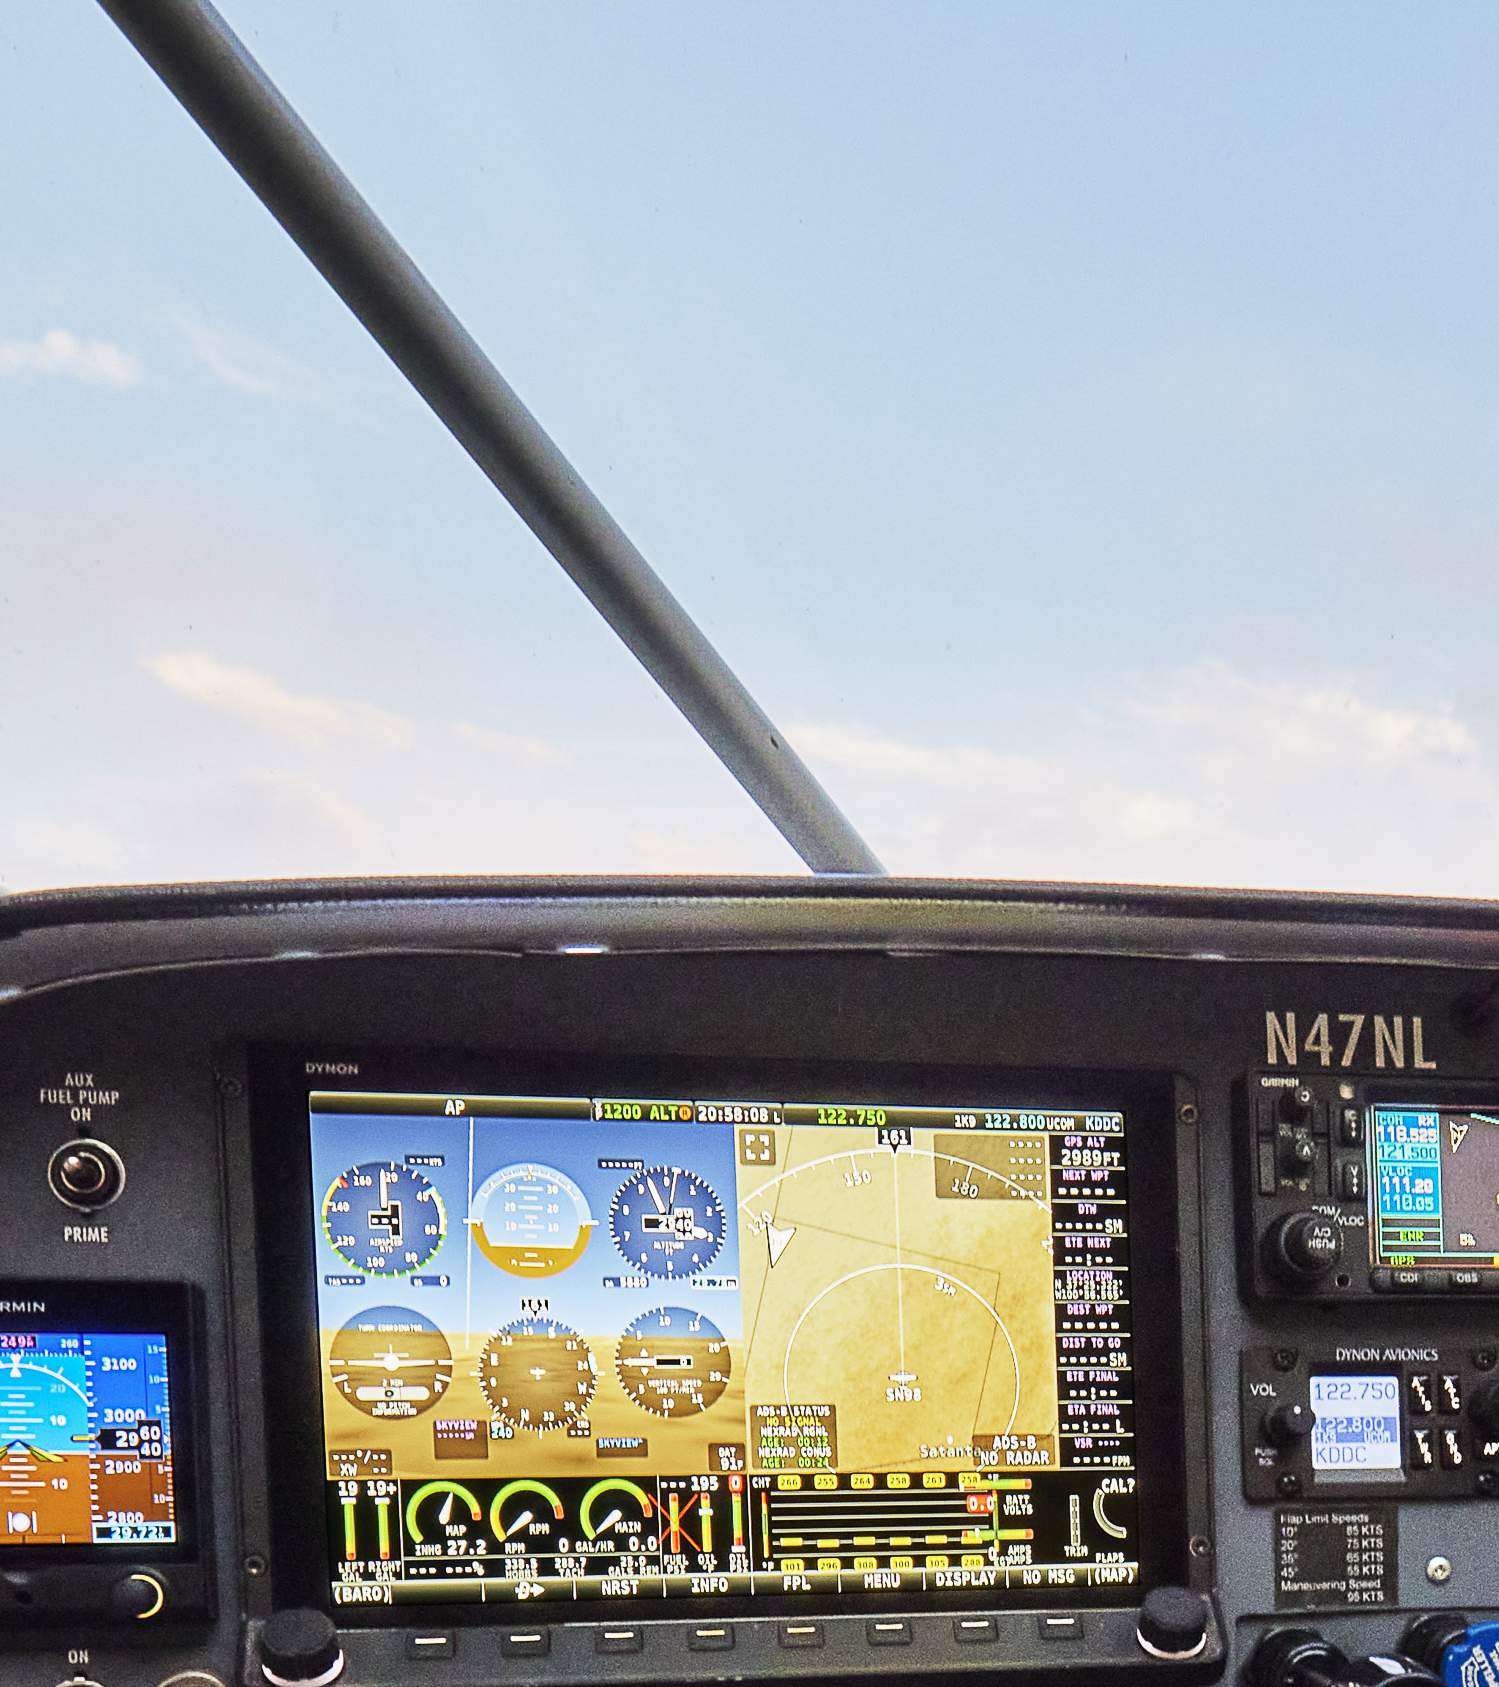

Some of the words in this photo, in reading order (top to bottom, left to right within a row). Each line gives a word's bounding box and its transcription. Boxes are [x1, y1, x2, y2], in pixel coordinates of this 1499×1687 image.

[1266, 1011, 1436, 1069] N47NL
[306, 1063, 358, 1075] DYNON
[65, 1073, 94, 1087] AUX
[40, 1089, 73, 1104] FUEL
[80, 1091, 119, 1105] PUMP
[71, 1108, 91, 1121] ON
[445, 1100, 465, 1116] AP
[604, 1104, 641, 1119] 1200
[650, 1106, 678, 1120] ALT
[698, 1107, 769, 1122] 20:58:08
[818, 1109, 886, 1125] 122.750
[881, 1130, 908, 1144] 161
[1379, 1144, 1437, 1159] 121.500
[844, 1170, 871, 1187] 150
[1063, 1170, 1087, 1181] NEXT
[952, 1179, 978, 1198] 180
[64, 1227, 108, 1242] PRIME
[1336, 1348, 1380, 1361] DYNON
[1383, 1349, 1438, 1361] AVIONICS
[102, 1358, 137, 1370] 3100
[1250, 1385, 1276, 1396] VOL
[1315, 1382, 1396, 1400] 122.750
[104, 1409, 145, 1422] 3000
[1316, 1418, 1383, 1432] 122.800
[993, 1436, 1036, 1450] ADS-B
[981, 1451, 998, 1465] NO
[1006, 1451, 1049, 1465] RADAR
[1316, 1447, 1367, 1463] KDDC
[52, 1478, 68, 1490] 10
[691, 1477, 718, 1491] 195
[1102, 1479, 1136, 1493] CAL?
[783, 1576, 811, 1590] FPL
[864, 1573, 900, 1588] MENU
[936, 1572, 996, 1586] DISPLAY
[1023, 1570, 1041, 1584] NO
[1048, 1569, 1075, 1583] MSG
[1095, 1569, 1133, 1584] (MAP)
[602, 1580, 639, 1595] NRST
[691, 1578, 728, 1593] INFO
[68, 1651, 88, 1664] ON
